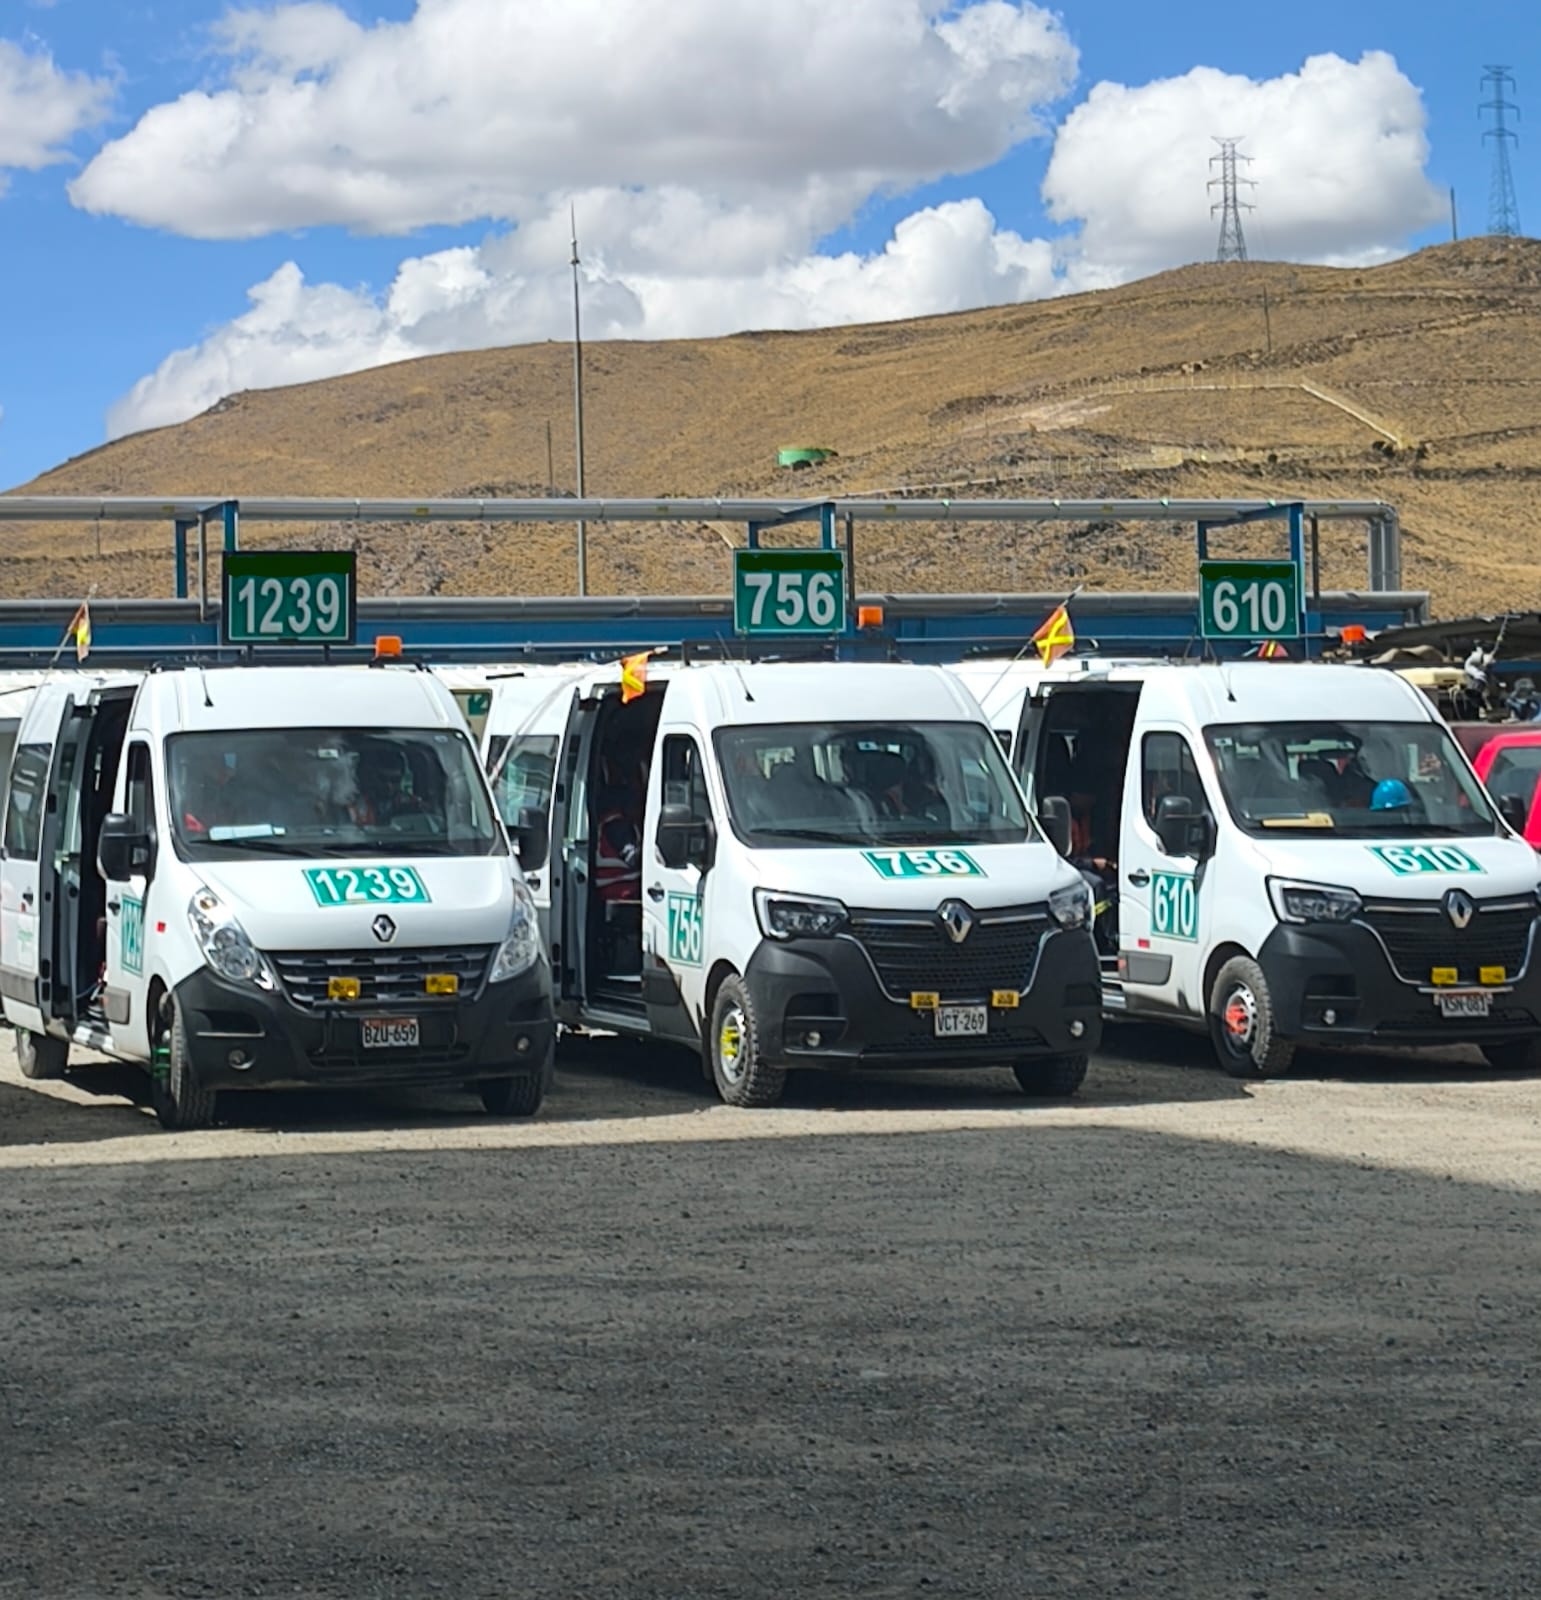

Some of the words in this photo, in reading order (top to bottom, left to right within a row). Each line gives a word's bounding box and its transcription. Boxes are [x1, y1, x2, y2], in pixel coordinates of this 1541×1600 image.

[238, 578, 340, 633] 1239
[744, 572, 836, 626] 756
[1213, 581, 1286, 632] 610
[872, 851, 970, 875] 756
[1381, 846, 1470, 872] 610
[316, 868, 417, 902] 1239
[1155, 875, 1195, 936] 610
[669, 898, 701, 961] 756
[364, 1023, 417, 1044] BZU-659
[937, 1012, 985, 1032] VCT-269
